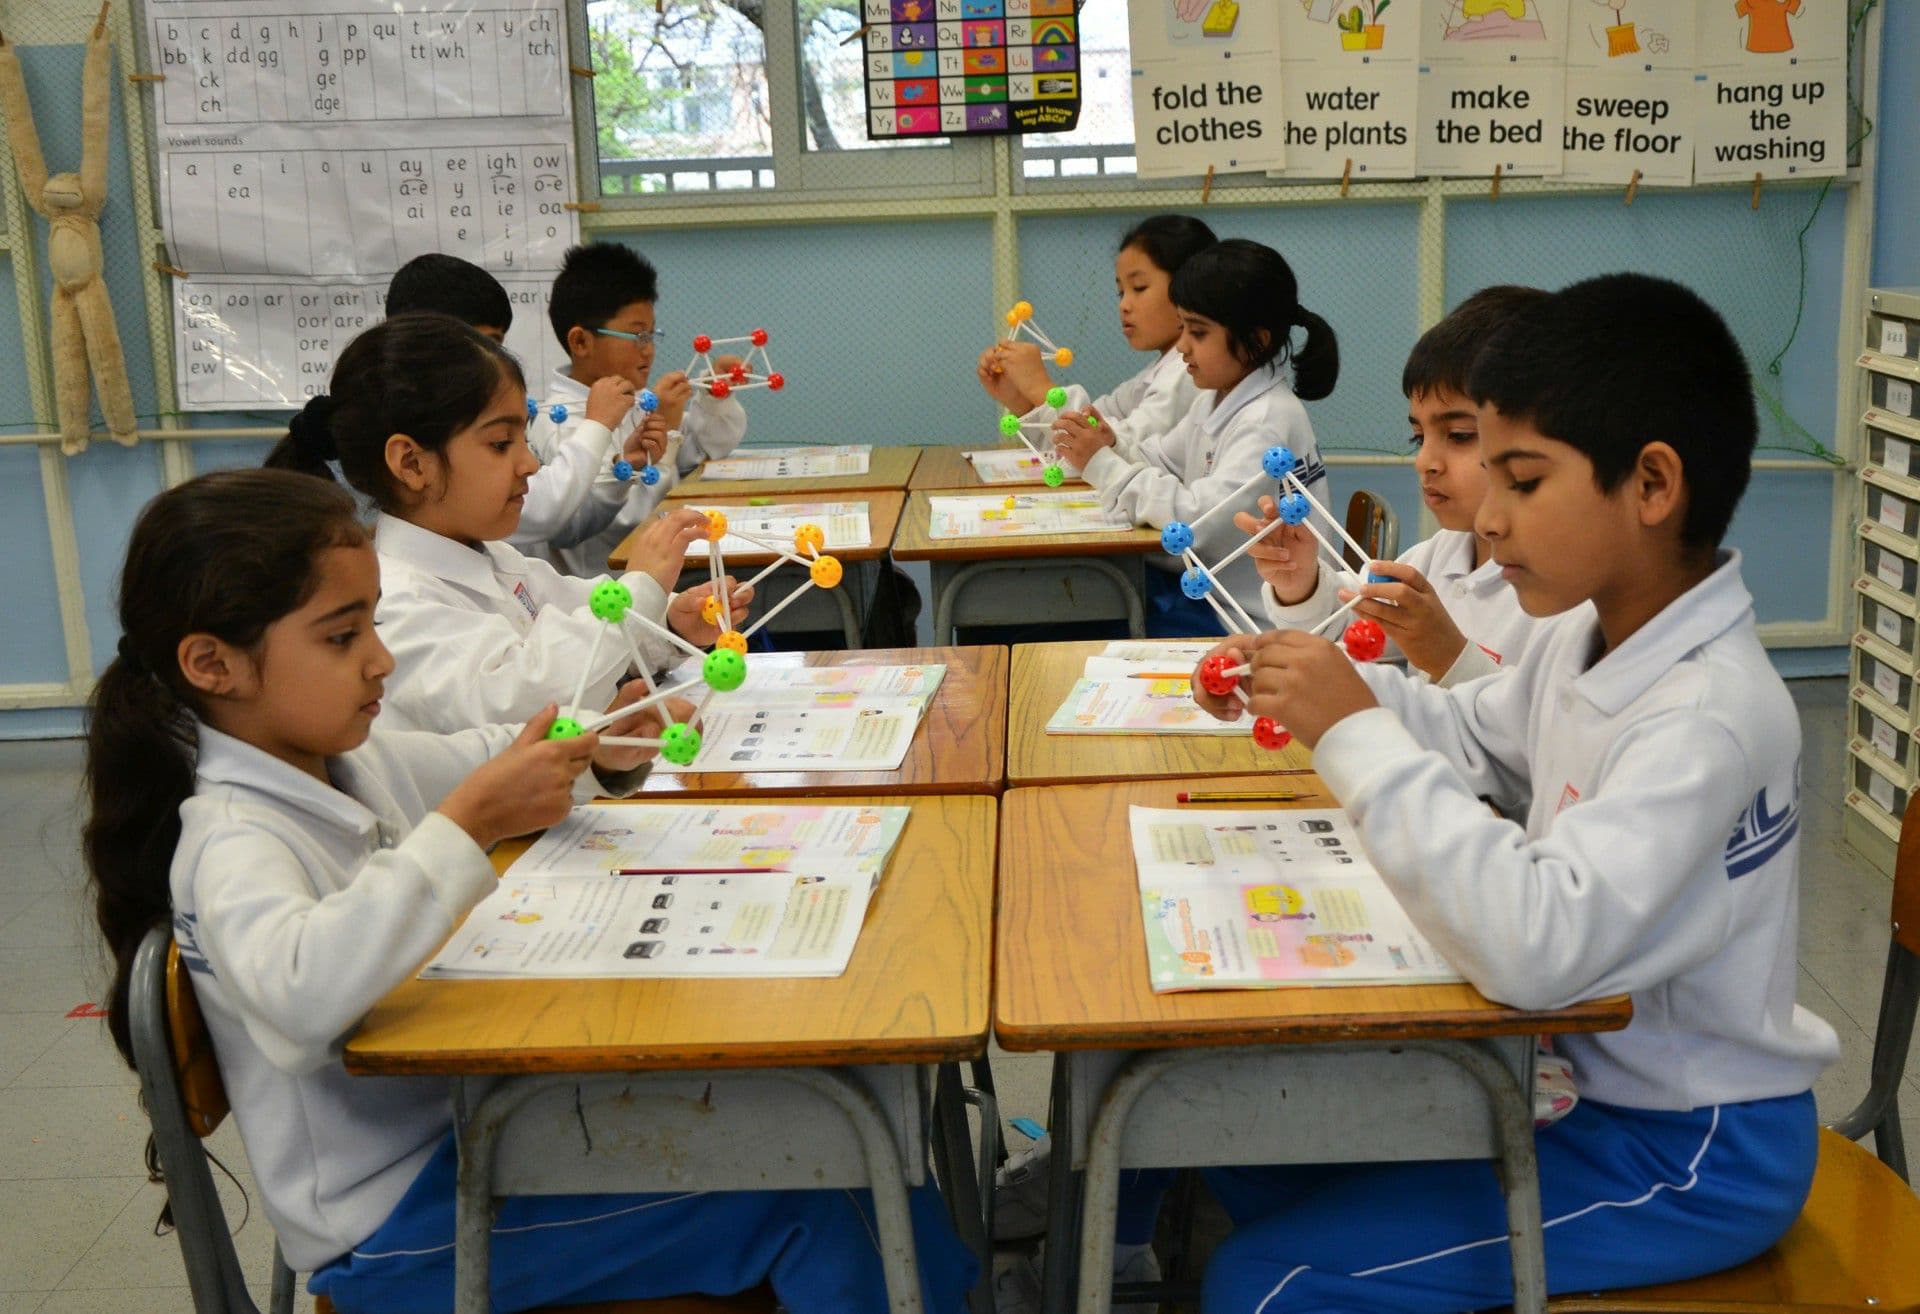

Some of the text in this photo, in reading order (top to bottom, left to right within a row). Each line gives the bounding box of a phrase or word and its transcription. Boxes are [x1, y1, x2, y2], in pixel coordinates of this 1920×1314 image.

[868, 4, 890, 16] Mm
[940, 1, 957, 14] Nn
[168, 24, 178, 40] b
[201, 28, 209, 40] c
[230, 22, 241, 40] d
[260, 26, 270, 43] g
[289, 22, 298, 38] h
[317, 22, 323, 42] j
[347, 24, 357, 41] p
[373, 24, 395, 39] qu
[413, 22, 419, 35] t
[477, 22, 485, 34] x
[504, 20, 513, 37] y
[530, 15, 550, 32] ch
[871, 25, 1026, 47] Pp Qq Rr
[164, 39, 555, 68] bb k dd gg g pp tt wh tch
[944, 56, 959, 69] Tt
[1012, 54, 1028, 67] Uu
[200, 71, 336, 90] ck ge
[876, 80, 1029, 100] Vv Ww Xx
[201, 94, 340, 114] ch dge
[1152, 82, 1263, 111] fold the
[1306, 86, 1380, 111] water
[1451, 85, 1530, 109] make
[1717, 81, 1825, 106] hang up
[876, 112, 961, 130] Yy Zz
[1576, 97, 1669, 125] sweep
[1751, 109, 1791, 132] the
[168, 136, 244, 147] Vowel sounds
[1156, 118, 1263, 145] clothes
[1284, 121, 1407, 151] he plants
[1436, 120, 1543, 144] the bed
[1563, 126, 1682, 154] the floor
[1715, 136, 1826, 163] washing
[186, 153, 560, 178] a e i o u ay ee igh ow
[229, 186, 250, 199] ea
[455, 182, 464, 198] y
[408, 203, 562, 218] ai ea ie oa
[458, 224, 556, 240] e i o
[504, 250, 513, 266] y
[227, 295, 249, 306] oo
[265, 294, 284, 306] ar
[302, 294, 318, 306] or
[334, 292, 359, 306] air
[298, 316, 364, 328] oor are
[300, 339, 328, 351] ore
[191, 362, 328, 374] ew aw
